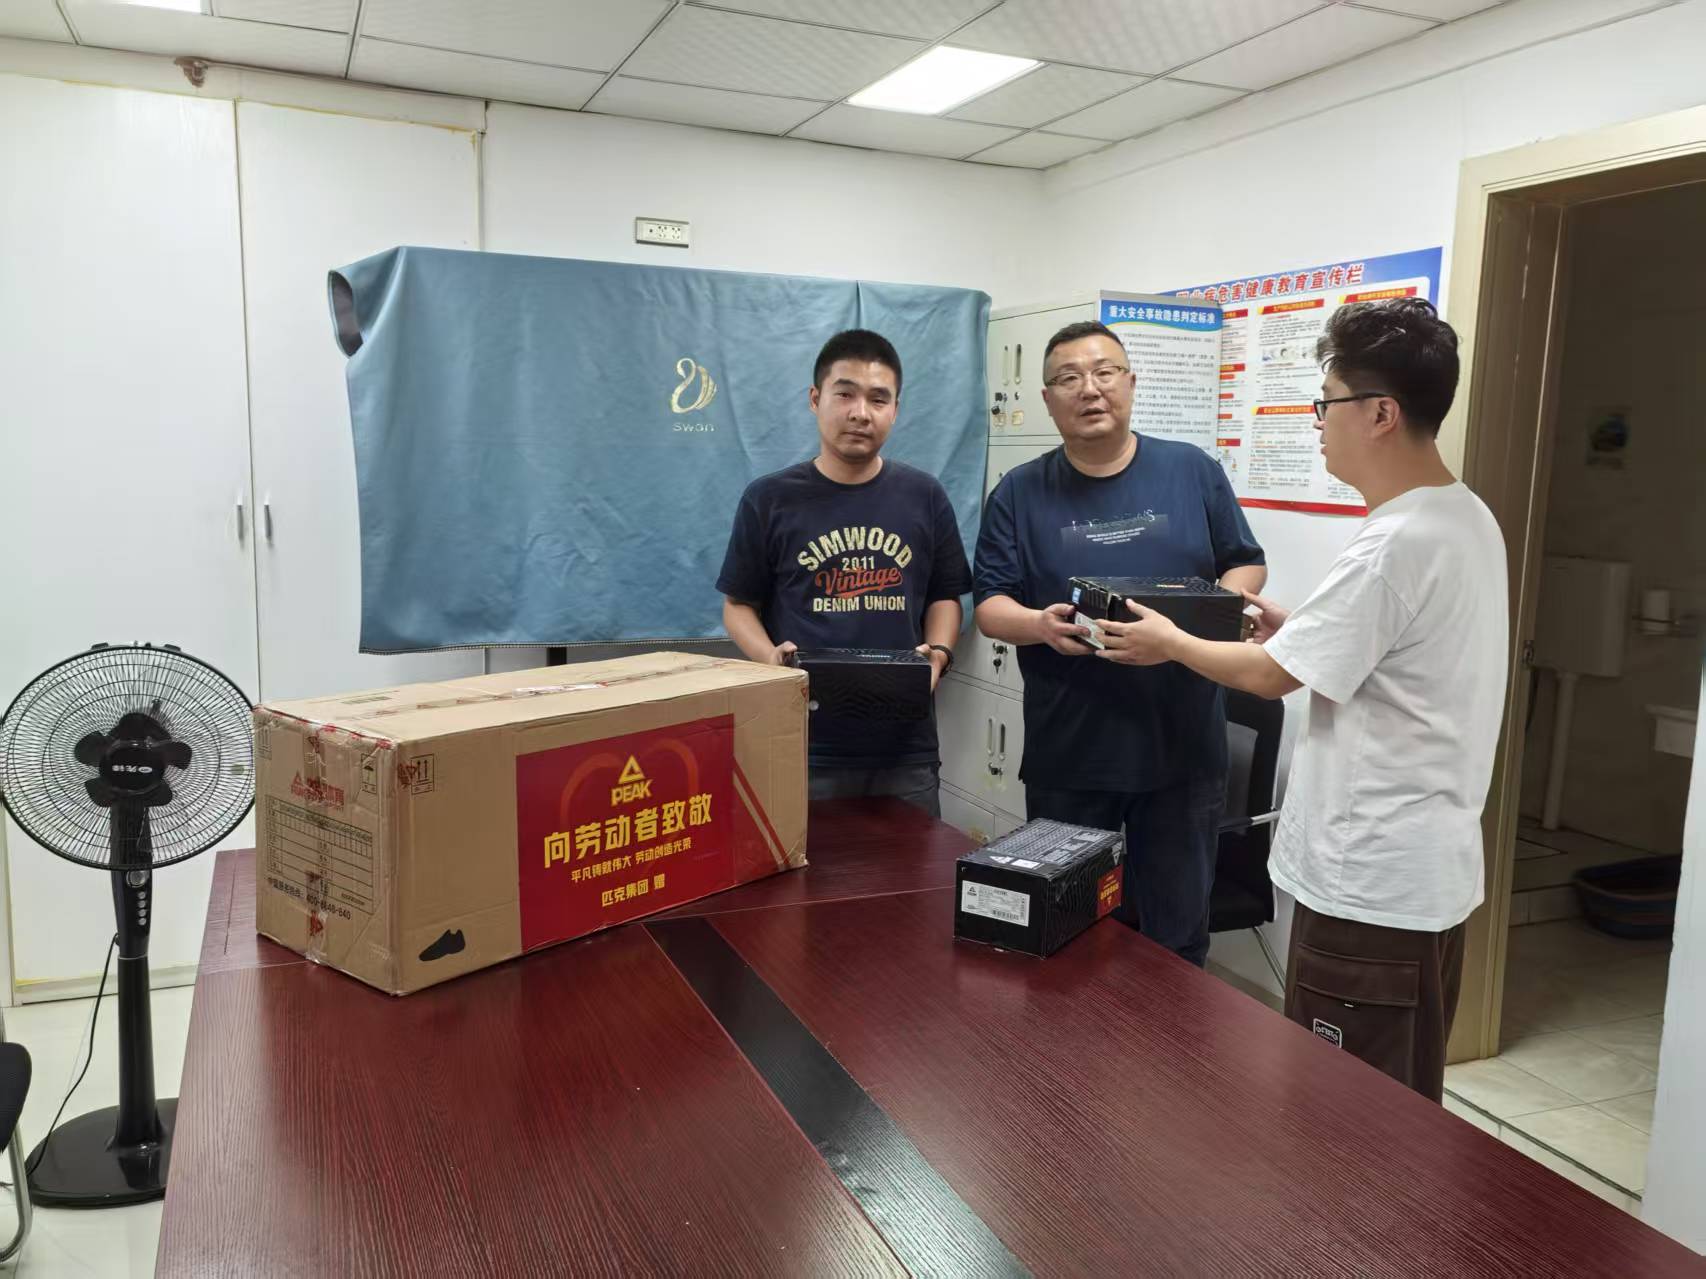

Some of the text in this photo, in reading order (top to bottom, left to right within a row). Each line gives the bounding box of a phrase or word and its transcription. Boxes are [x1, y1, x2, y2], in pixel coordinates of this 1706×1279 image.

[1176, 264, 1363, 303] 病危害健康教育宣传栏
[1109, 304, 1216, 324] 重大安全事故隐患判定标准
[797, 526, 913, 571] SIMWOOD
[841, 556, 875, 571] 2011
[815, 566, 904, 598] Vintage
[812, 595, 906, 613] DENIM UNION
[611, 779, 654, 807] PEAK
[544, 793, 713, 869] 向劳动者致敬
[571, 836, 692, 883] 平凡铸就伟大 劳动创造光荣
[601, 878, 649, 907] 匹克集团
